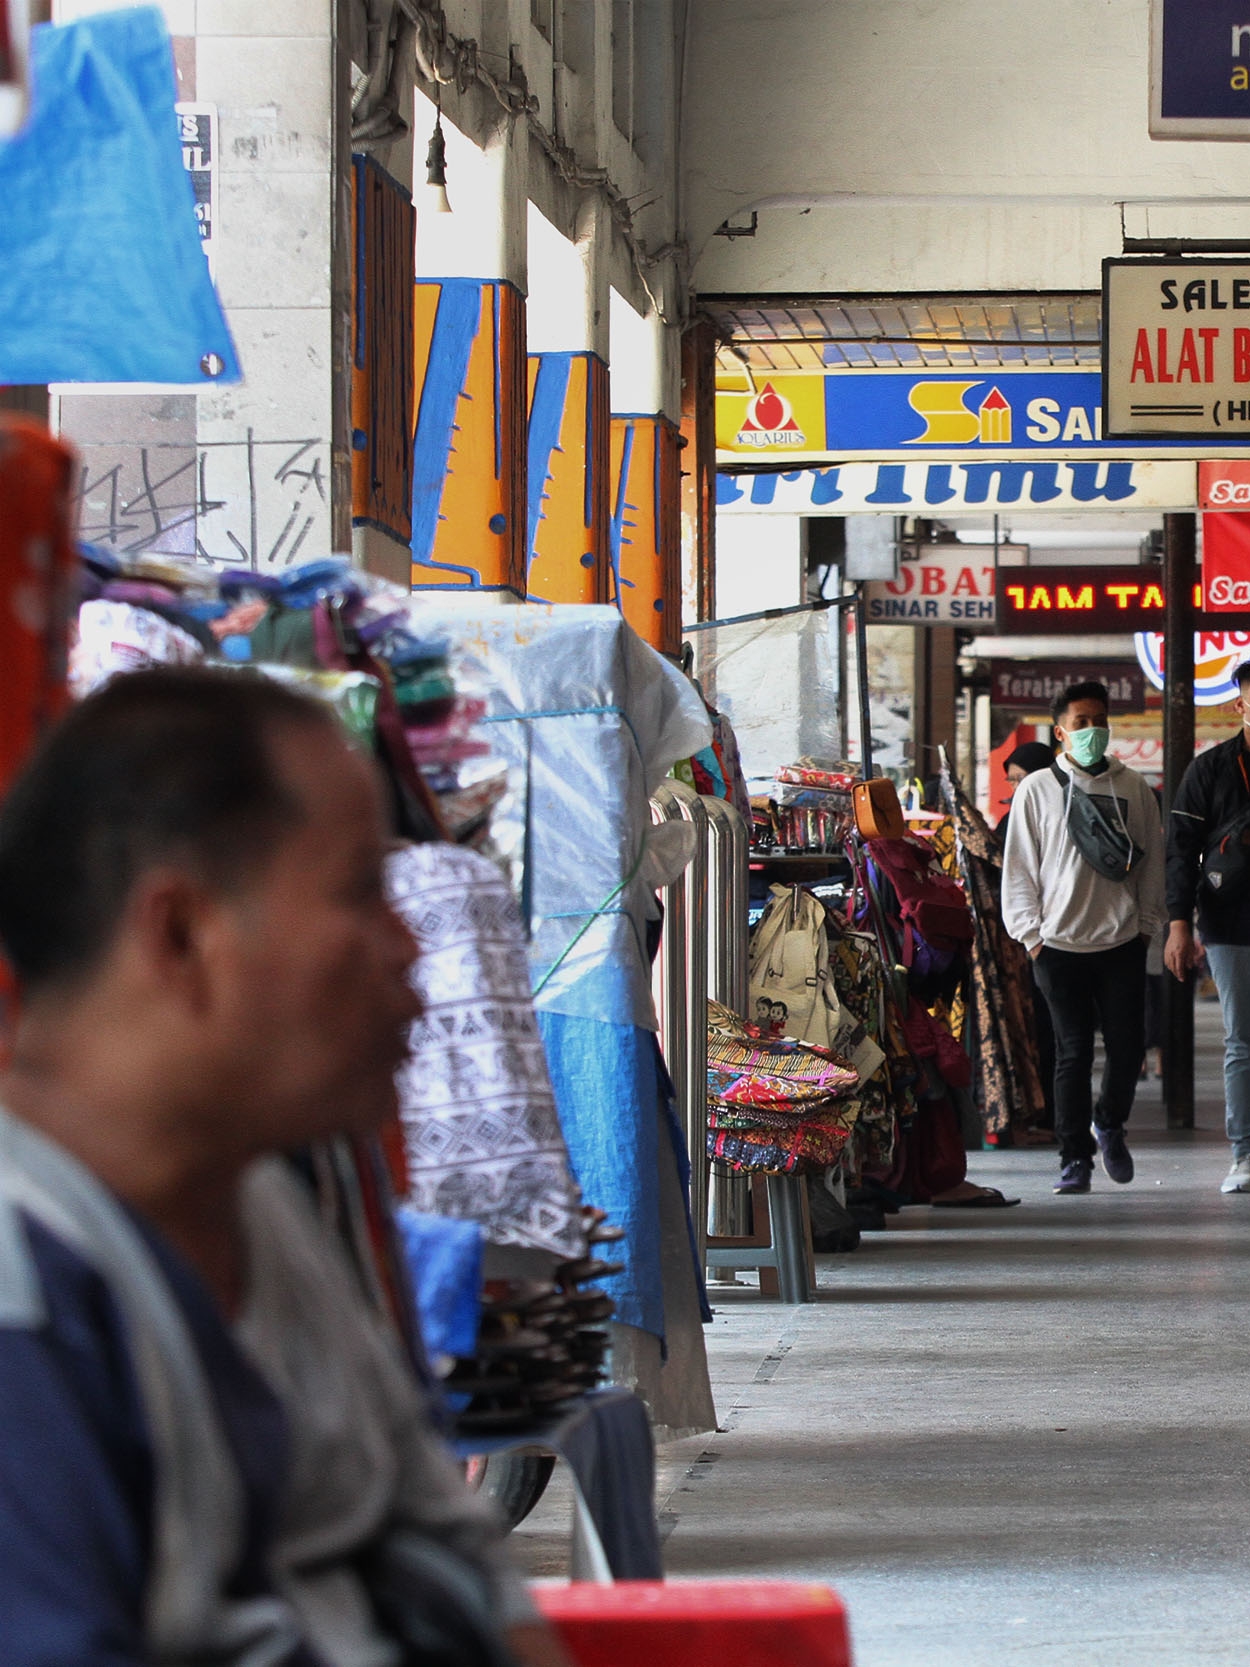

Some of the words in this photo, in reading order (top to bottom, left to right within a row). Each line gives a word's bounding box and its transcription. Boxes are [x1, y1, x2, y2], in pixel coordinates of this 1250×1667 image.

[1130, 327, 1219, 383] ALAT
[1026, 397, 1102, 442] SA
[870, 600, 938, 617] SINAR
[951, 601, 993, 618] SEH
